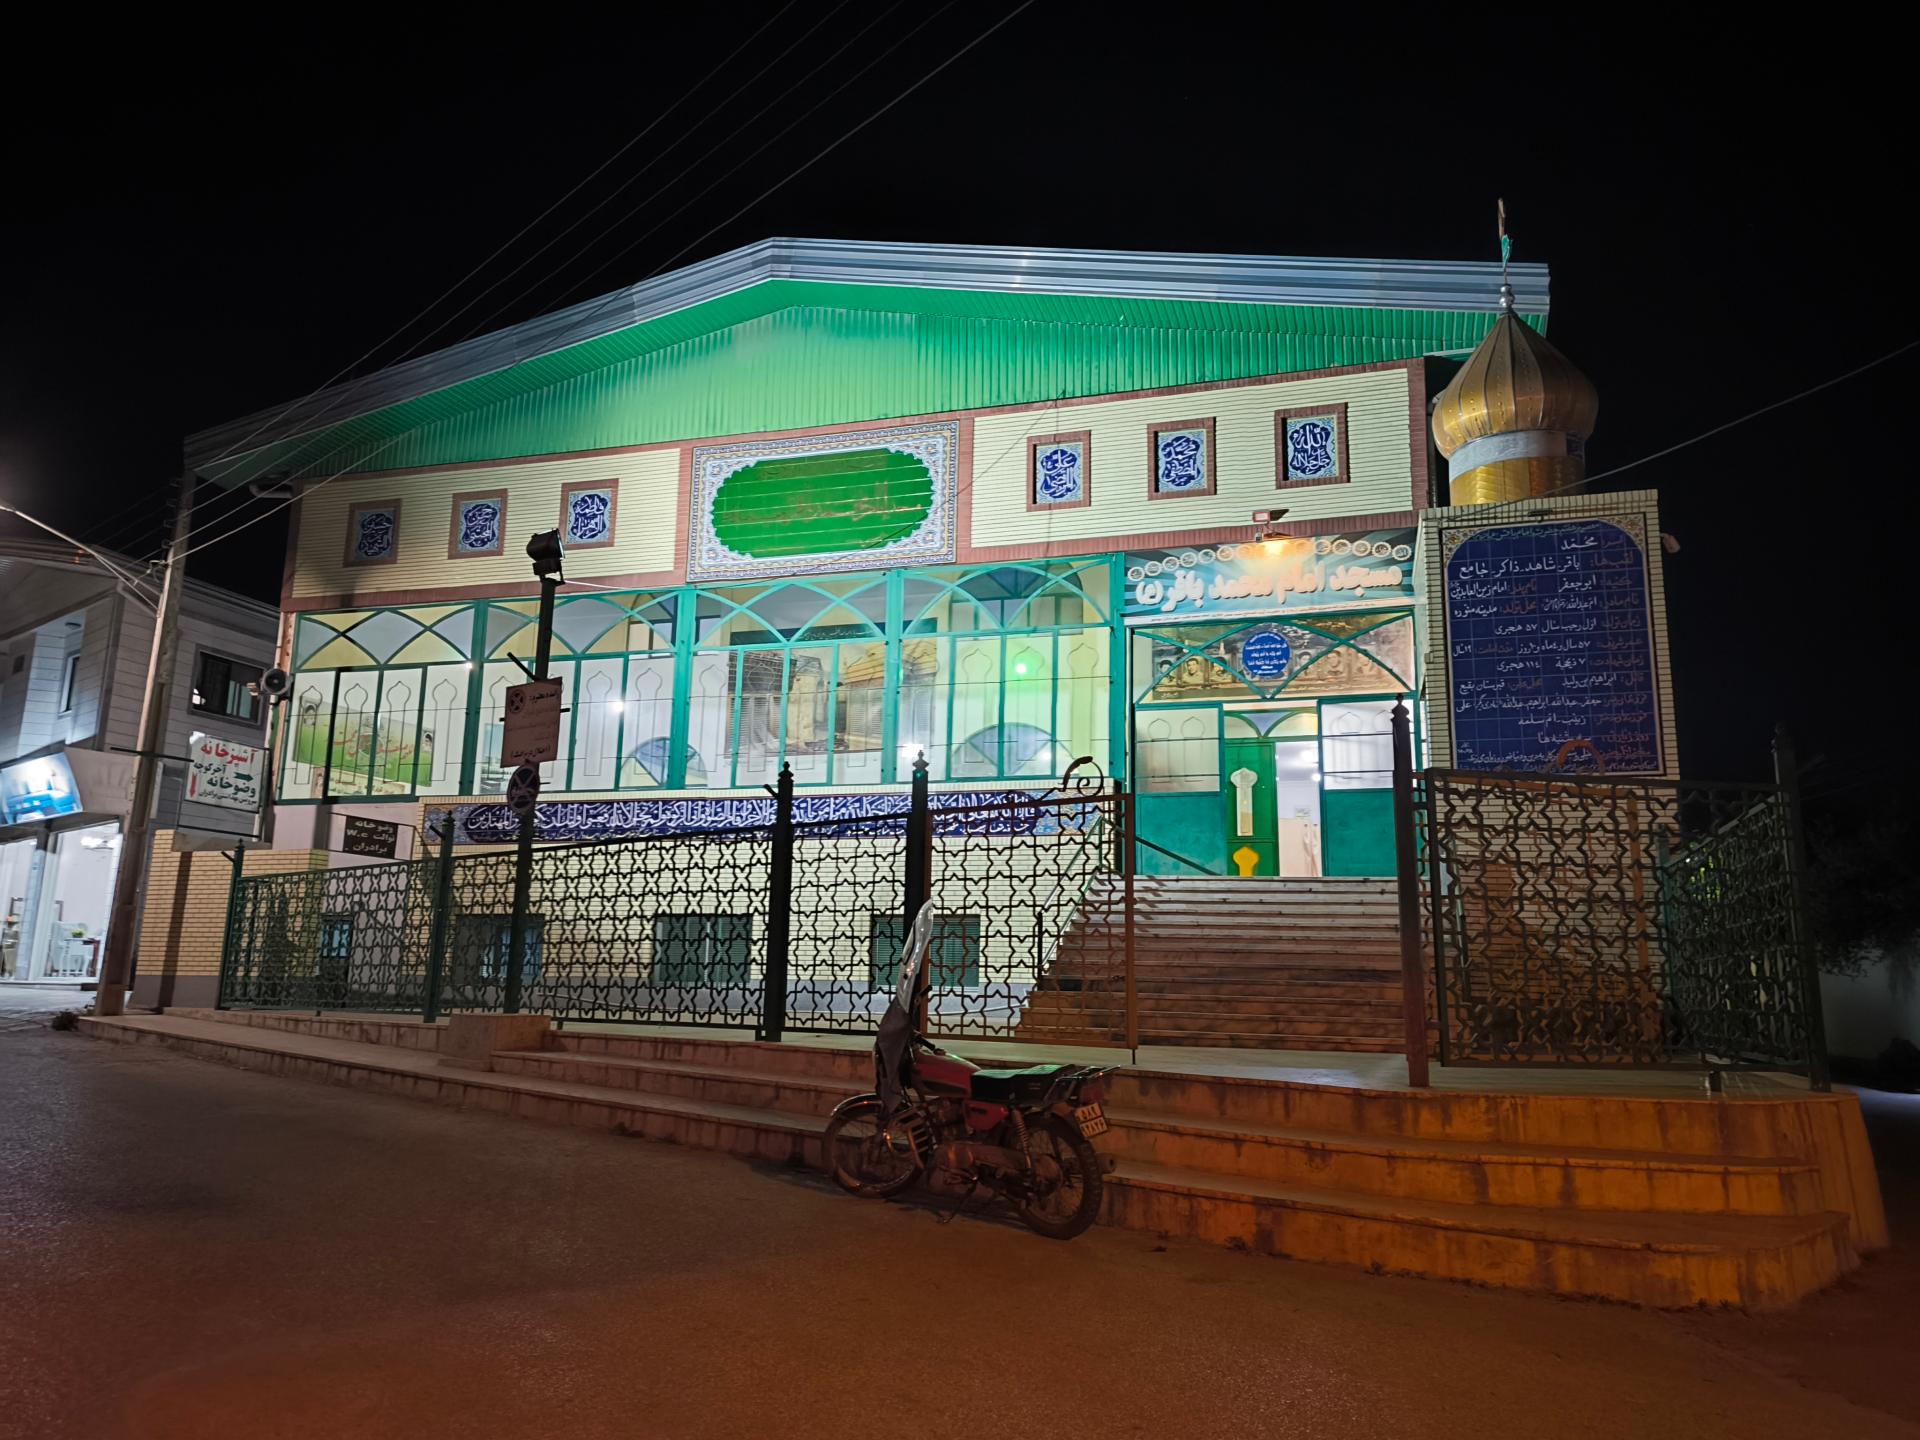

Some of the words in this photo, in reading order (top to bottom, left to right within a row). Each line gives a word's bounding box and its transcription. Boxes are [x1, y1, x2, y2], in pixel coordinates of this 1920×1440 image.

[1560, 536, 1598, 551] محمد
[1160, 570, 1205, 612] باقر
[1208, 573, 1274, 600] محمد
[1277, 560, 1327, 605] امام
[1330, 564, 1403, 597] مسجد
[1494, 625, 1523, 635] هجری
[1497, 661, 1525, 672] هجری
